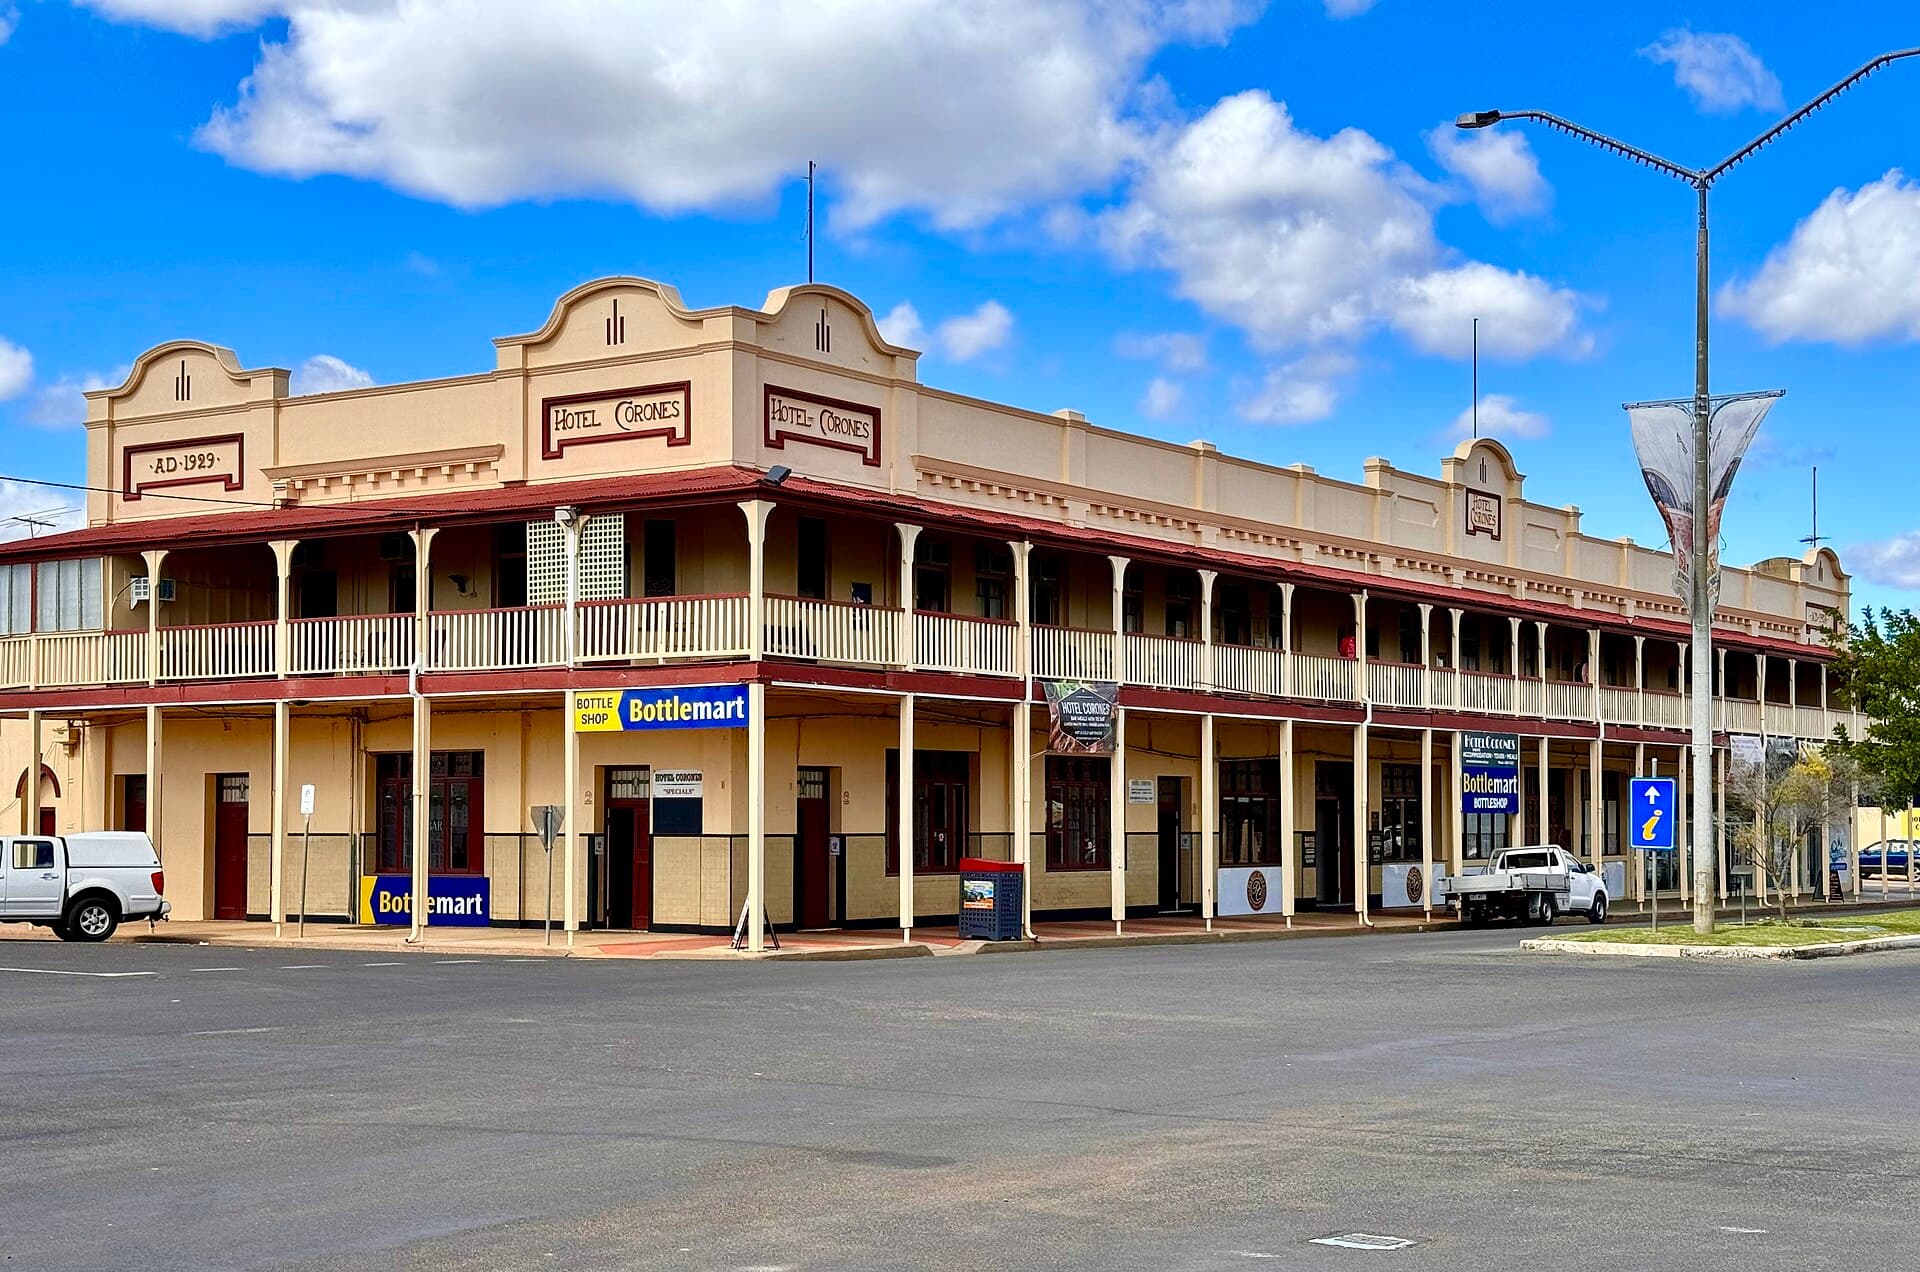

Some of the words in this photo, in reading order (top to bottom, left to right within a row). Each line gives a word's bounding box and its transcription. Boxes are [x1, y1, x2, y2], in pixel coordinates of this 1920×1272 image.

[554, 409, 601, 431] HOTEL
[615, 400, 680, 431] CORONES
[820, 409, 869, 438] CORONES
[576, 697, 613, 709] BOTTLE
[629, 695, 745, 723] Bottlemart
[1061, 701, 1082, 714] HOTEL
[1083, 702, 1110, 715] CORONES
[581, 713, 609, 725] SHOP
[1464, 734, 1485, 749] HOTEL
[1485, 735, 1516, 750] CORONES
[655, 773, 675, 782] HOTEL
[675, 773, 703, 782] CORONES
[1463, 771, 1518, 794] Bottlemart
[1473, 797, 1508, 809] BOTTLESHOP
[380, 890, 483, 915] Botemart
